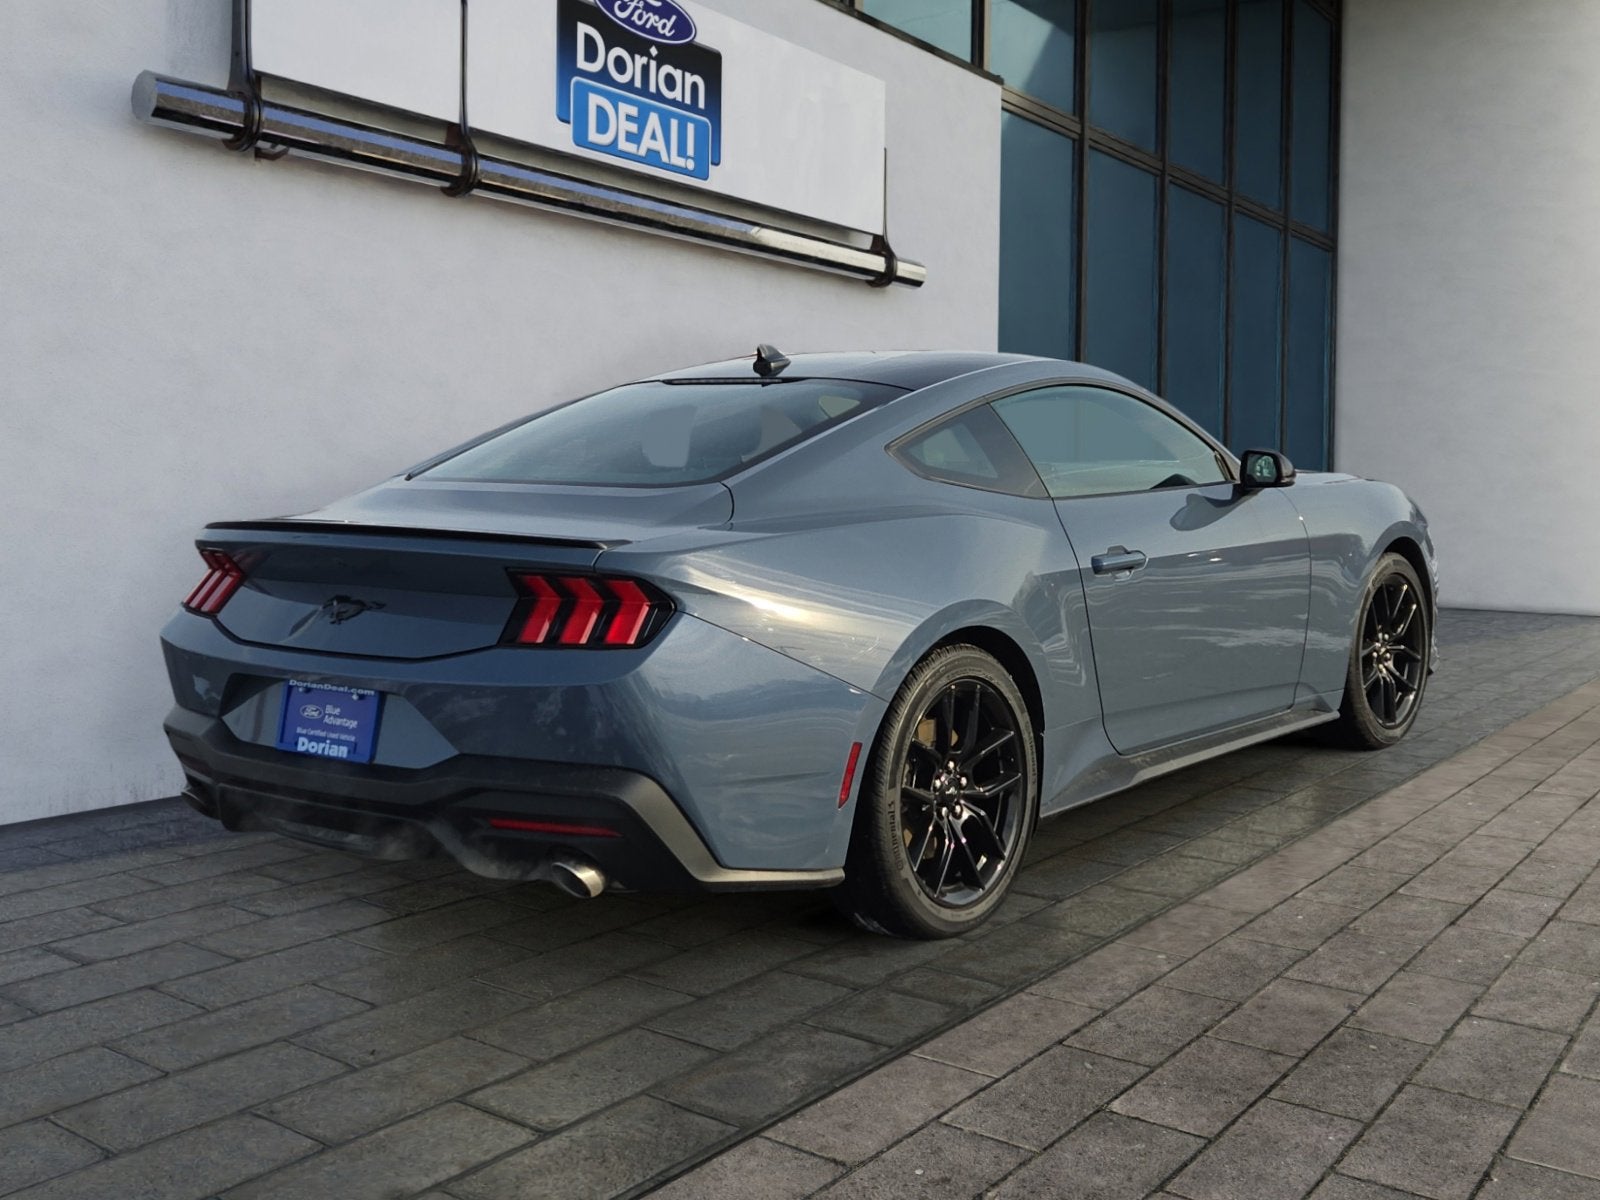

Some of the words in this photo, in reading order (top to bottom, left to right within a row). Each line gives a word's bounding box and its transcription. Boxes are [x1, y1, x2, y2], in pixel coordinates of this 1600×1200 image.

[614, 0, 676, 37] Ford
[576, 21, 705, 109] Dorian
[588, 92, 695, 171] DEAL!
[289, 679, 375, 695] DorianDeal.com
[325, 704, 341, 715] Blue
[323, 715, 358, 729] Advantage
[297, 737, 348, 758] Dorian
